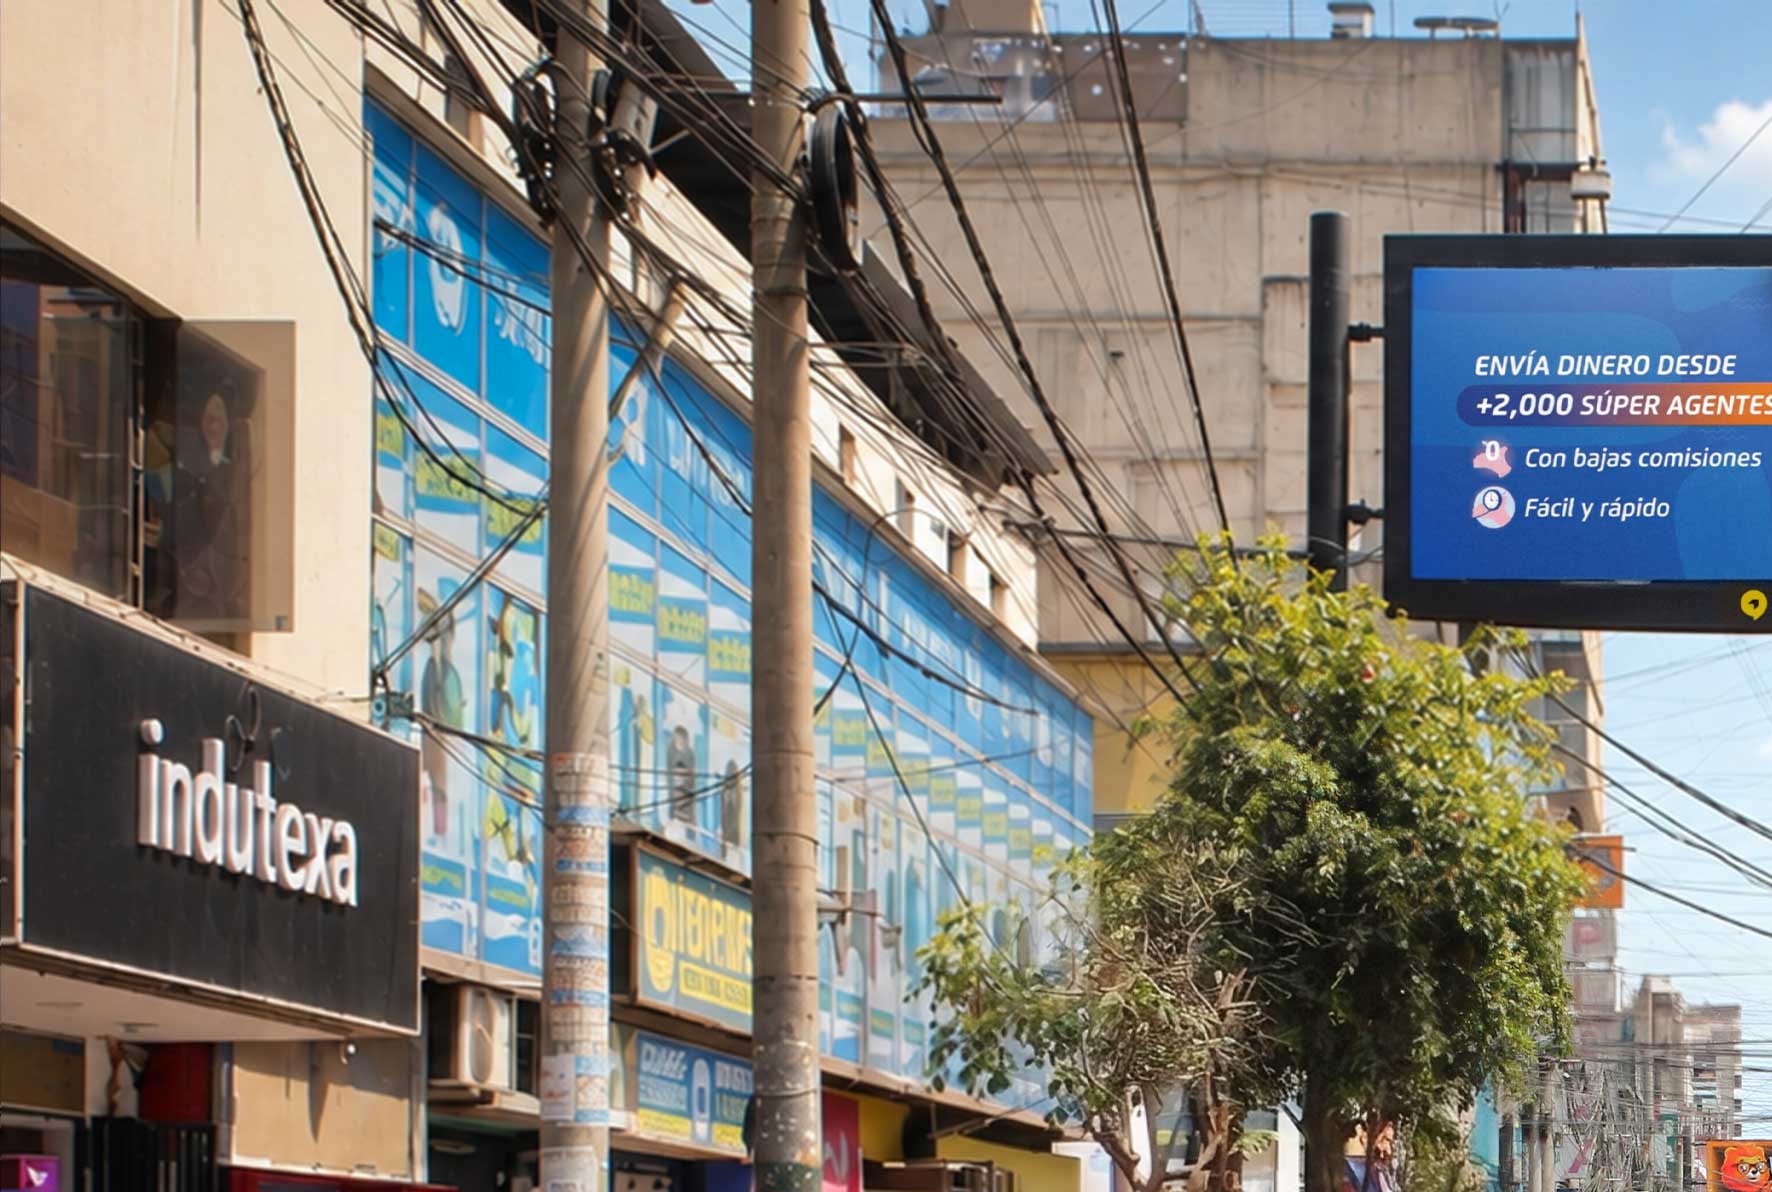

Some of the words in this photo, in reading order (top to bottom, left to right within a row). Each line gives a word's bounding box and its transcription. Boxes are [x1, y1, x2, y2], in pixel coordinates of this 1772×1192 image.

[1475, 350, 1550, 376] ENVÍA
[1557, 355, 1650, 376] DINERO
[1657, 354, 1737, 376] DESDE
[1476, 393, 1574, 420] +2,000
[1580, 390, 1660, 415] SÚPER
[1525, 449, 1566, 468] Con
[1573, 448, 1632, 472] bajas
[1638, 448, 1763, 468] comisiones
[1525, 497, 1574, 518] Fácil
[1581, 502, 1595, 522] y
[1600, 498, 1671, 522] rápido
[138, 718, 358, 907] indutexa
